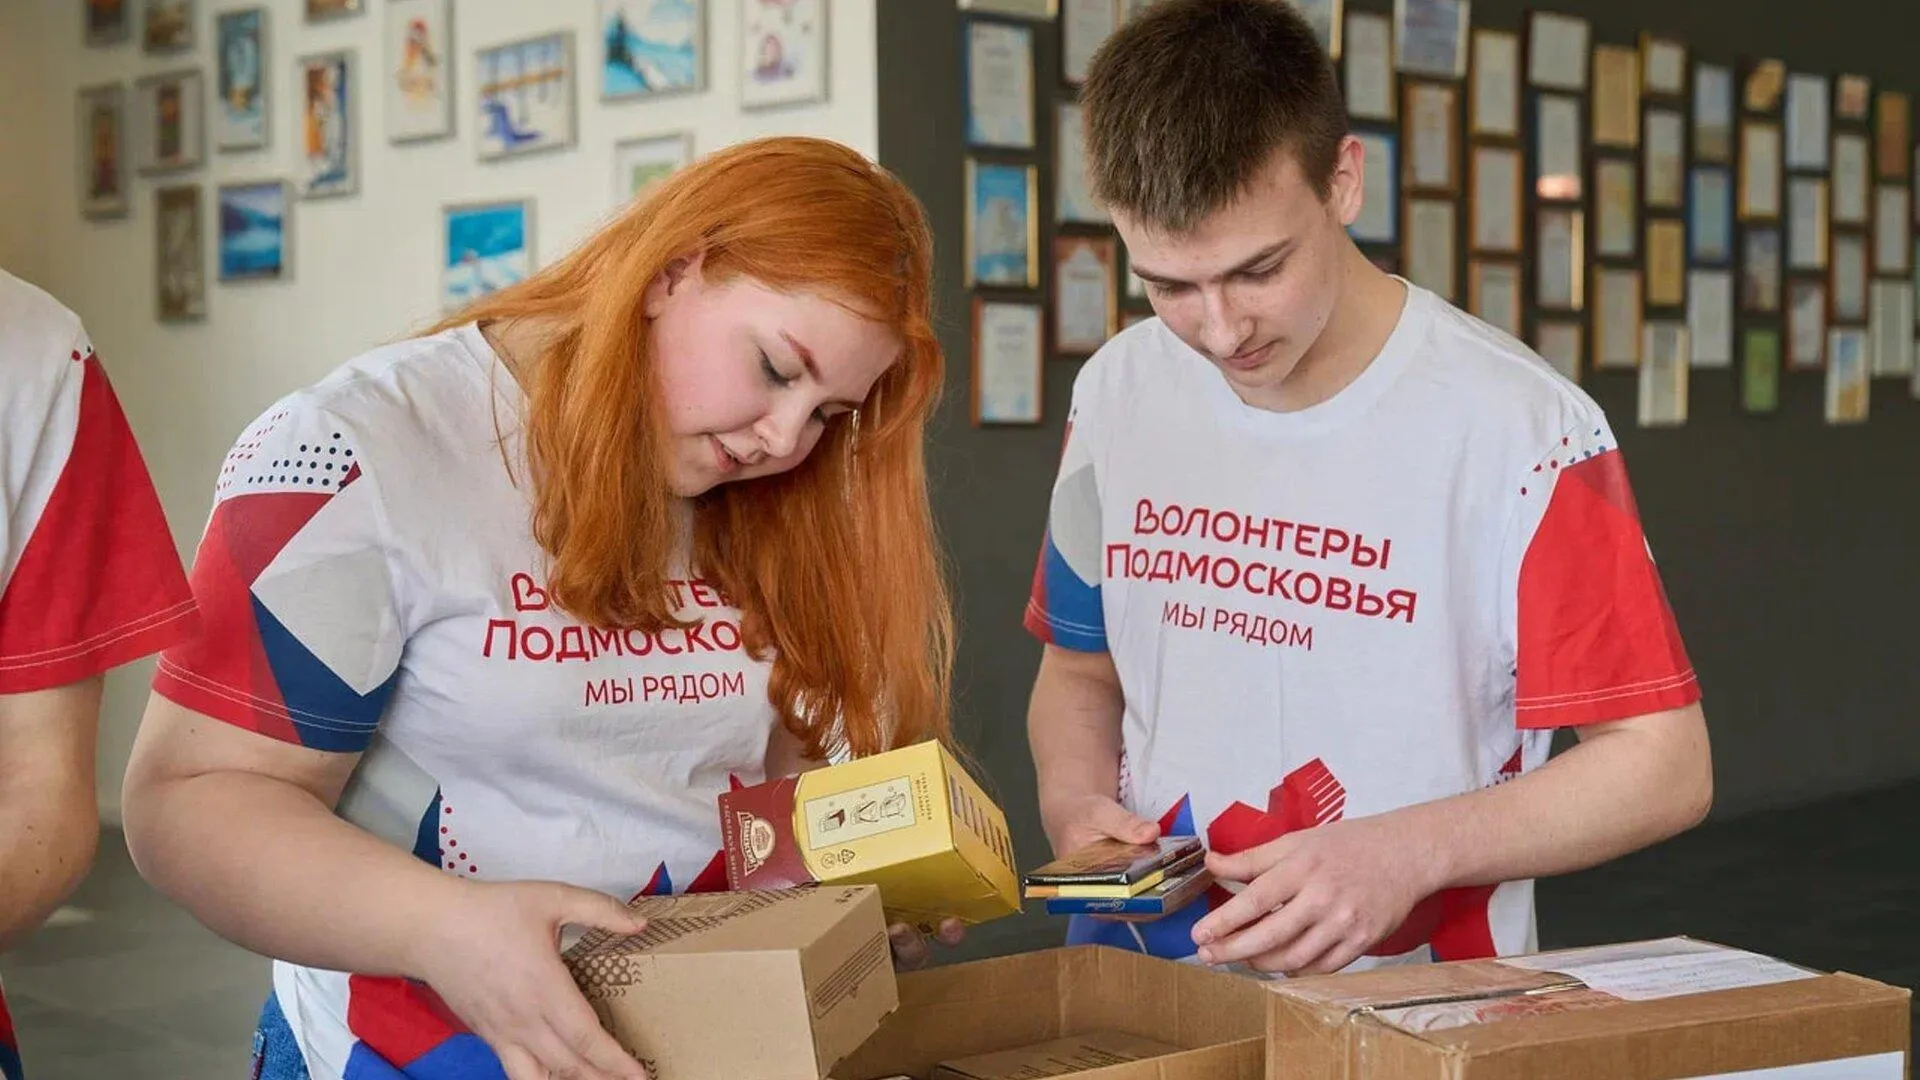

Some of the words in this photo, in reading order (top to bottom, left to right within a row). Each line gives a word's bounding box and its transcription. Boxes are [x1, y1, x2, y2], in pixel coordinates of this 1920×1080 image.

[1134, 499, 1391, 570] ВОЛОНТЕРЫ
[1106, 544, 1417, 623] ПОДМОСКОВЬЯ
[483, 618, 743, 663] ПОДМОСКО
[1162, 601, 1205, 630] МЫ
[1213, 608, 1313, 651] РЯДОМ
[585, 677, 634, 706] МЫ
[643, 671, 745, 704] РЯДОМ
